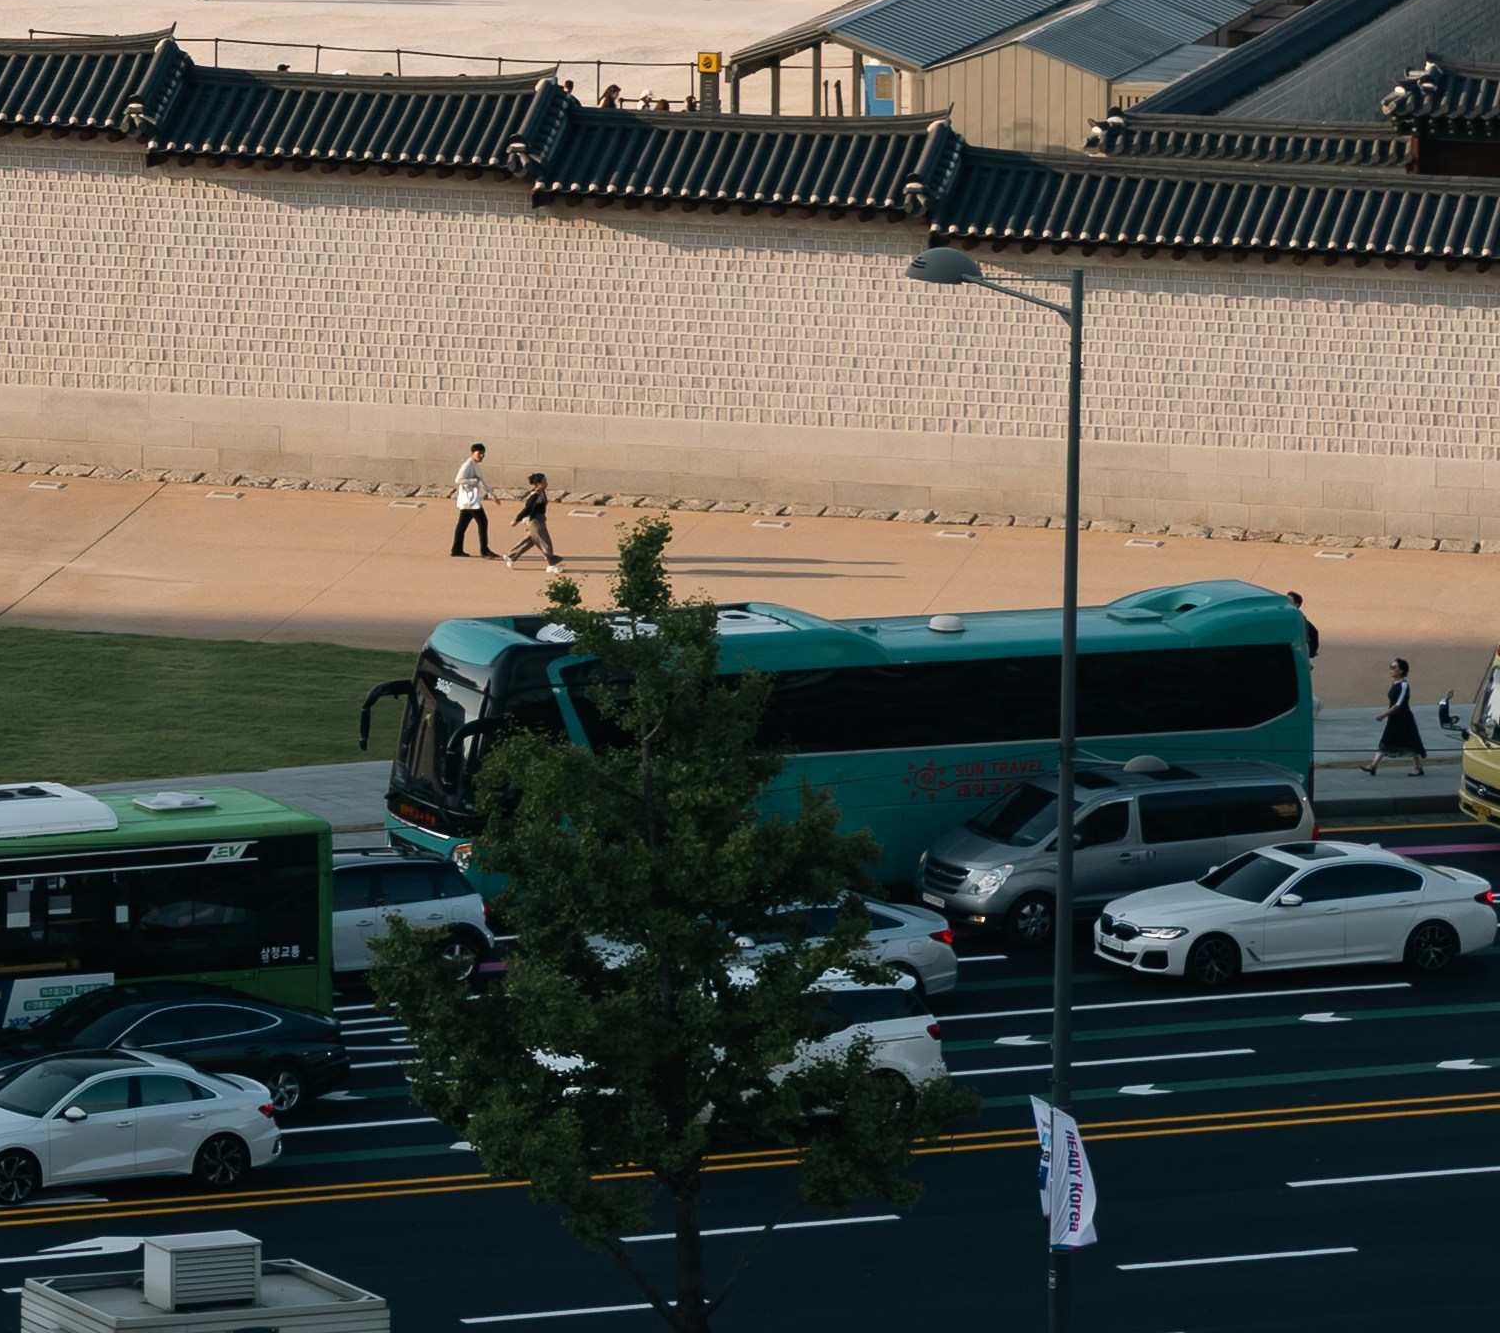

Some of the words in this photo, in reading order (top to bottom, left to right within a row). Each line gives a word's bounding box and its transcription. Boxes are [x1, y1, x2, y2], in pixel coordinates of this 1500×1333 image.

[956, 762, 985, 778] SUN
[990, 758, 1045, 775] TRAVEL
[260, 945, 301, 961] 삼청교통
[1064, 1130, 1083, 1178] READY
[1068, 1181, 1084, 1233] Korea
